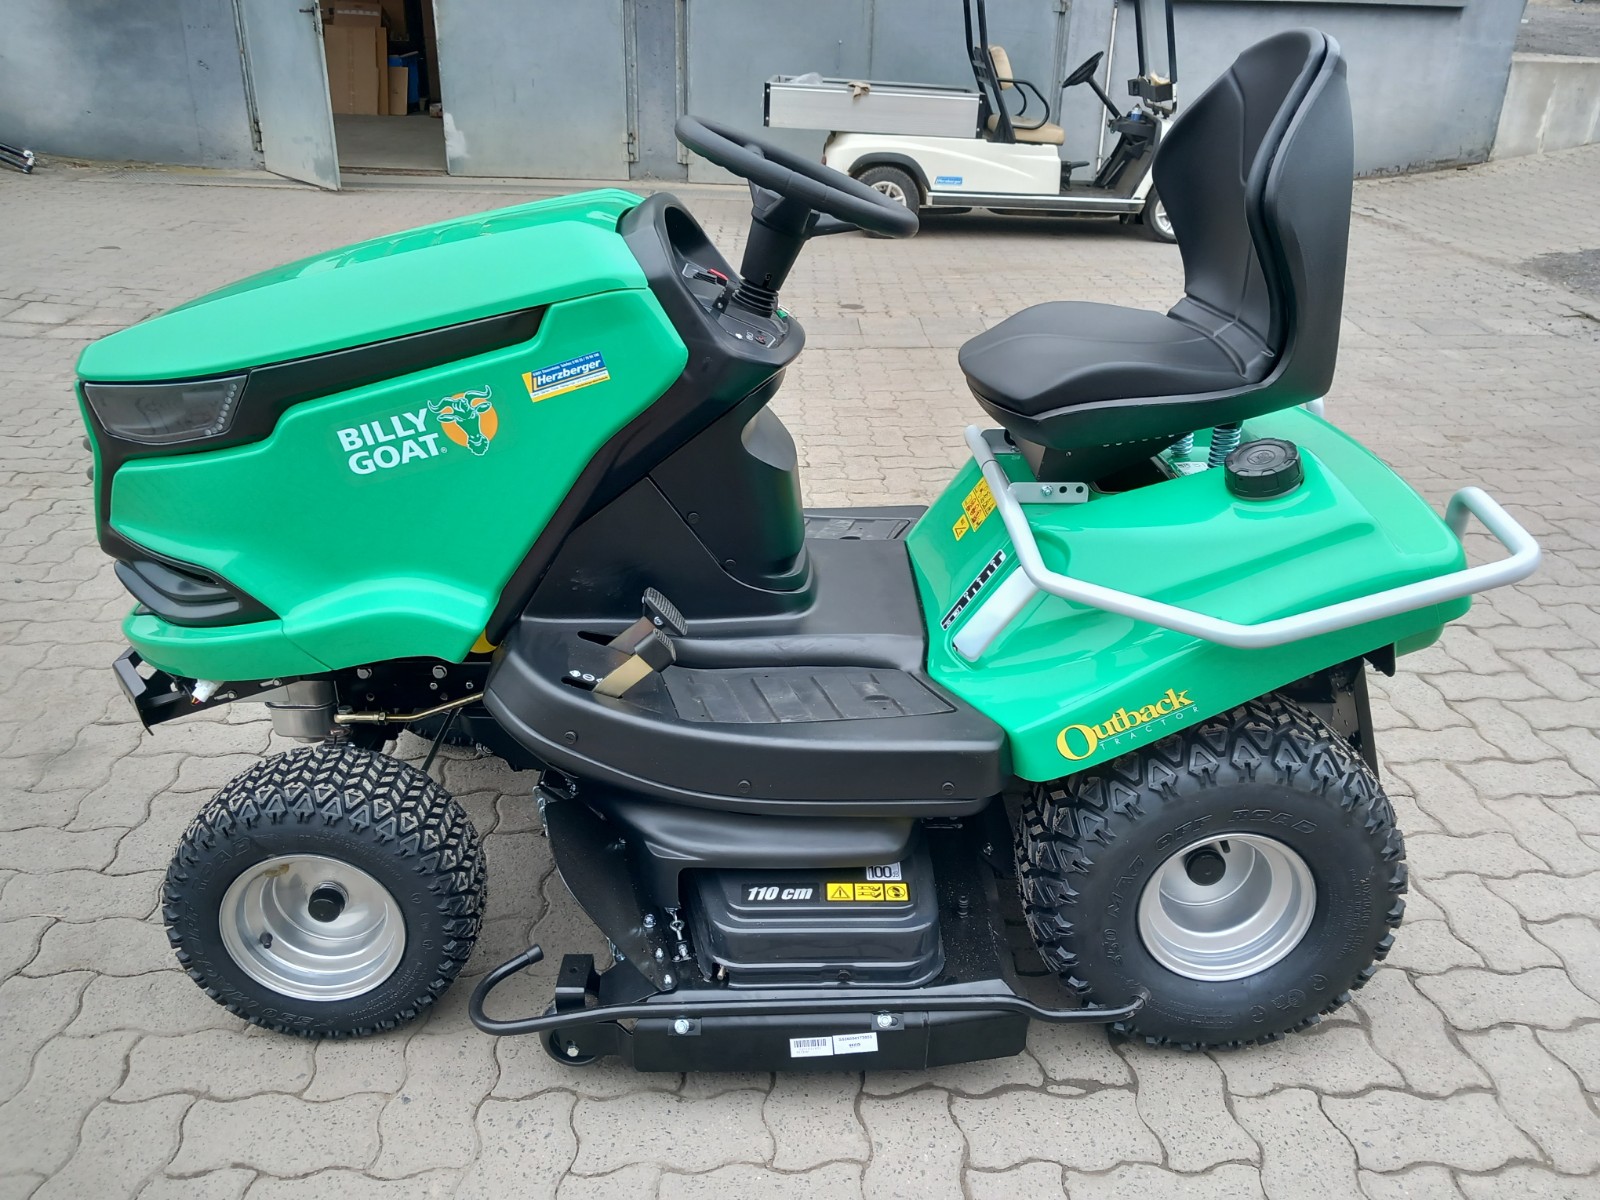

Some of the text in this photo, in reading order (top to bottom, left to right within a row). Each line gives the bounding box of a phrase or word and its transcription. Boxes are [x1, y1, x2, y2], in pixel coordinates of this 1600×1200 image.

[537, 359, 602, 386] Herzberger
[336, 407, 428, 452] BILLY
[348, 433, 439, 475] GOAT
[1056, 688, 1195, 761] Outback
[1100, 705, 1199, 750] TRACTOR
[1153, 813, 1214, 852] OFF
[1226, 808, 1319, 835] ROAD
[869, 865, 892, 878] 100
[748, 886, 813, 901] 110 cm
